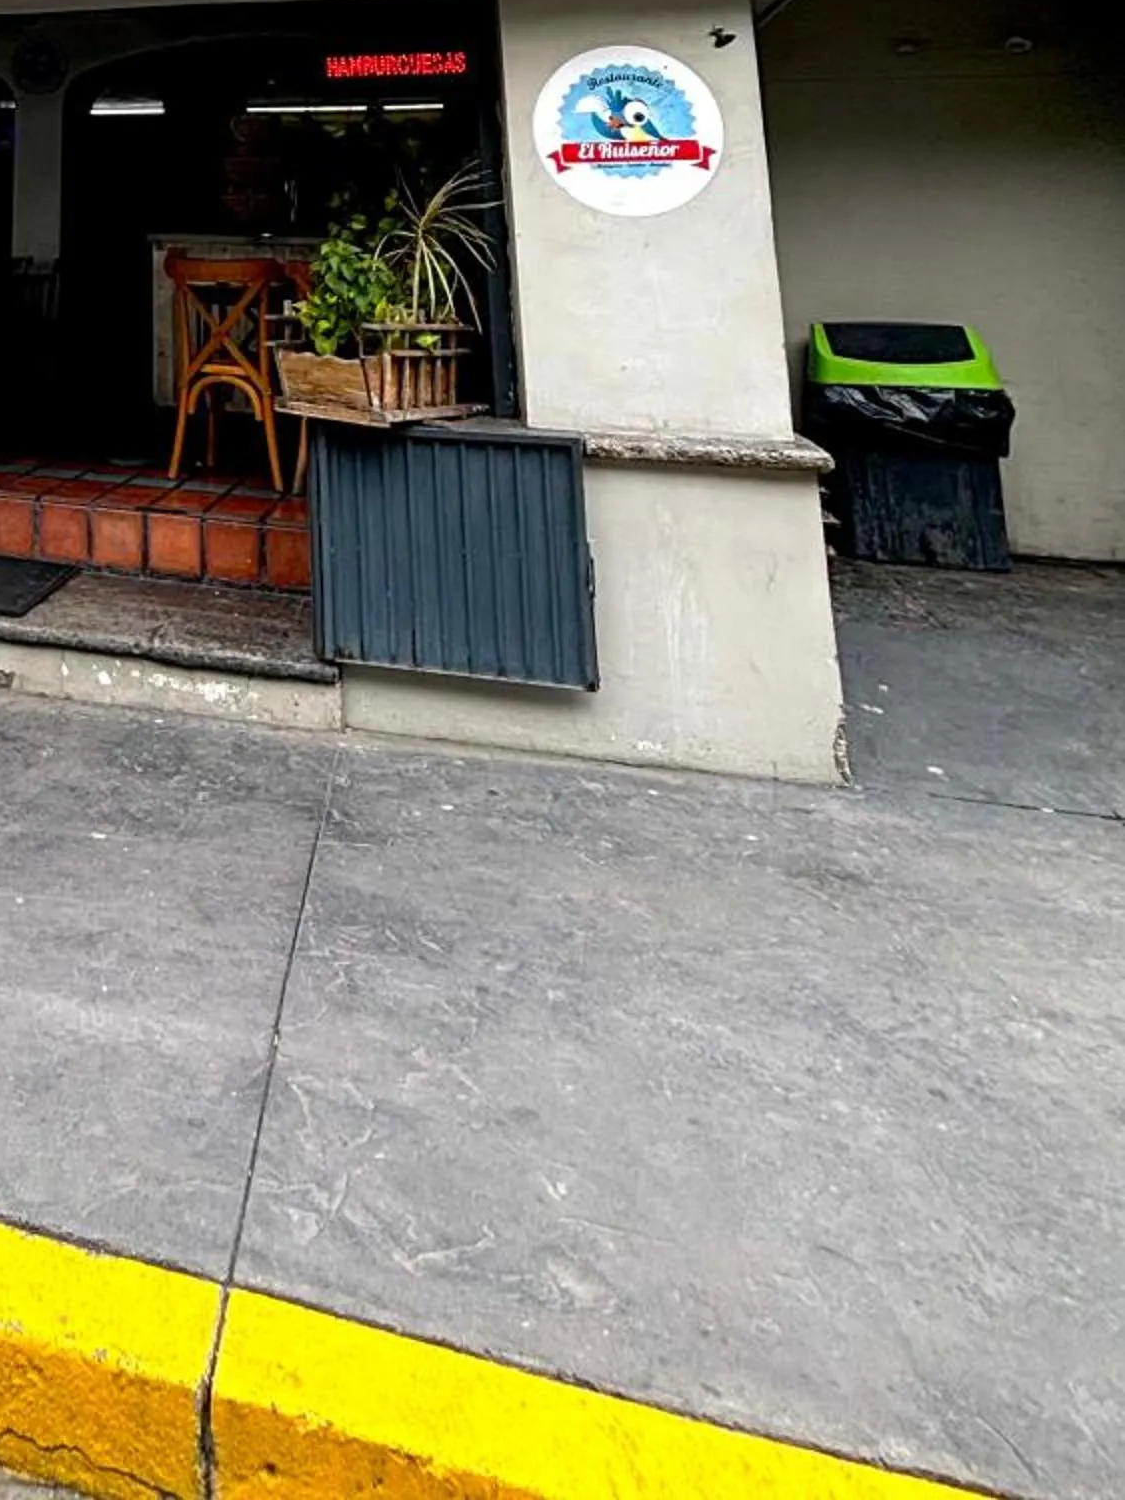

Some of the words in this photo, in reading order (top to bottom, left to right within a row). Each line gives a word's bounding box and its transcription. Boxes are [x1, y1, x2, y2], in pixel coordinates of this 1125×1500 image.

[586, 72, 665, 90] Restaurante
[578, 143, 595, 159] El
[599, 141, 679, 159] Ruiseñor
